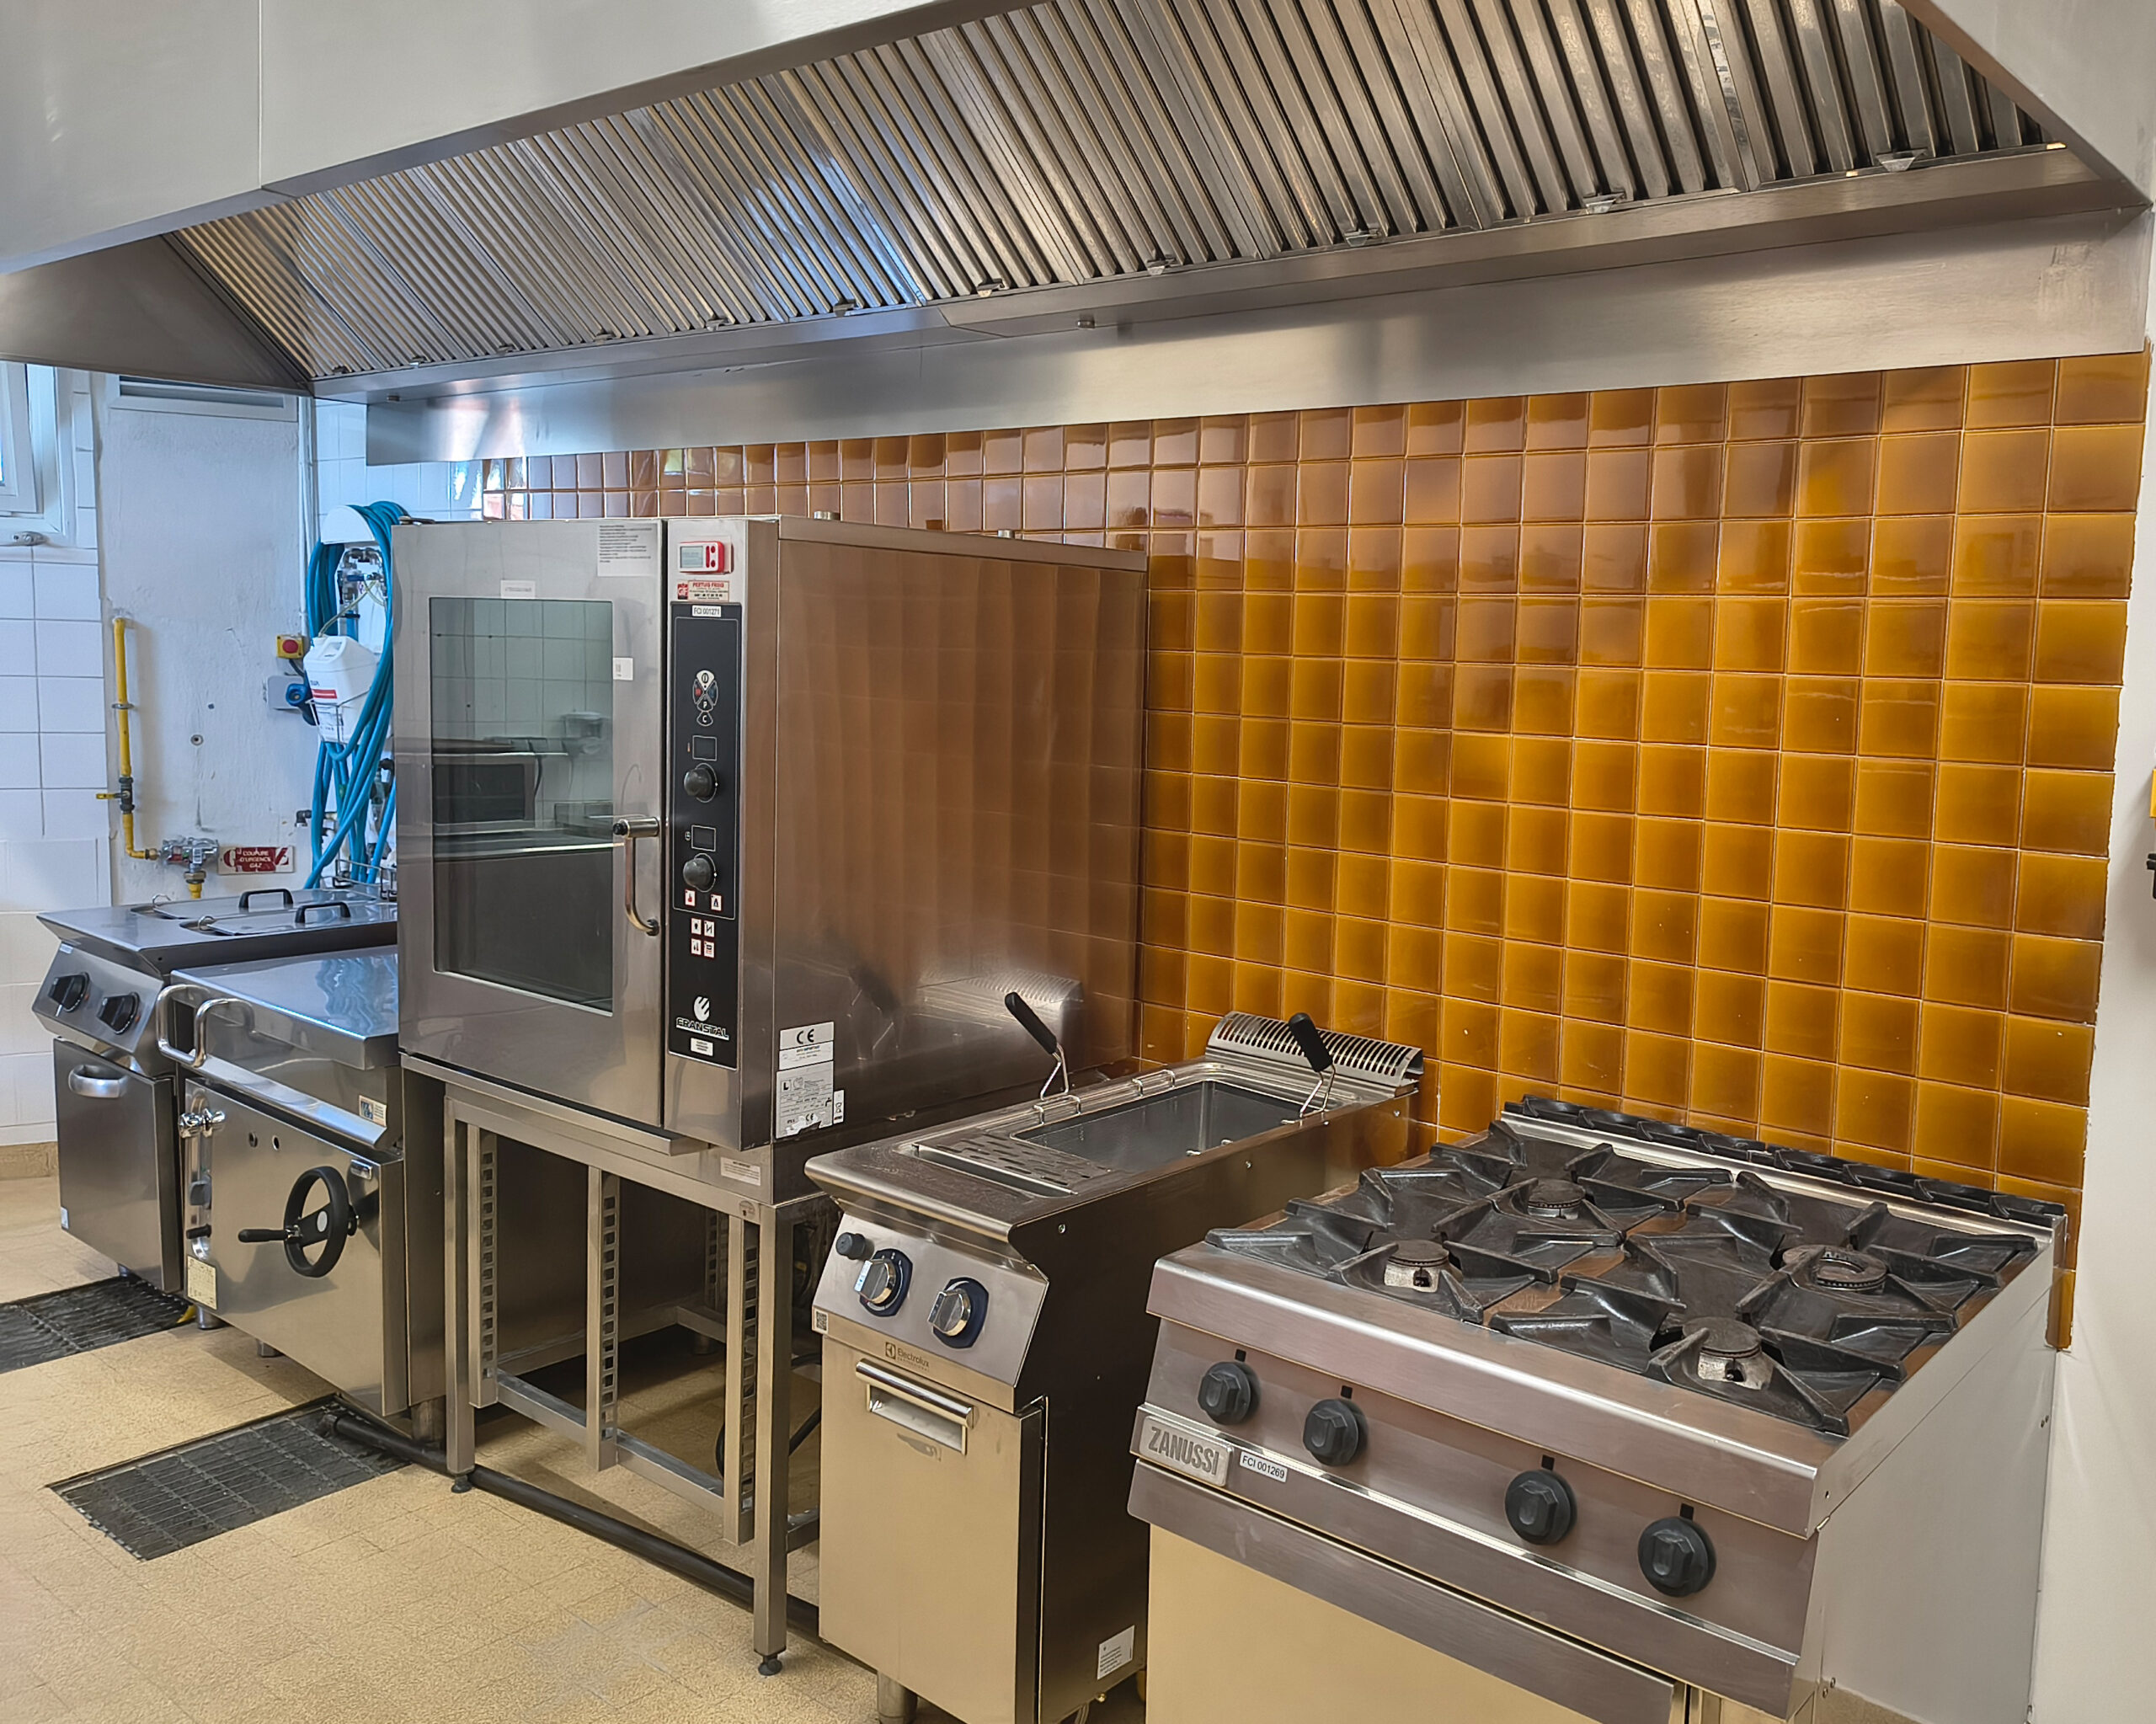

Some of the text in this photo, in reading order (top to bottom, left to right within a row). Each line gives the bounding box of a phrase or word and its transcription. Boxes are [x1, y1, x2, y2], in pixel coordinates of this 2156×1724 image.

[796, 1028, 814, 1044] CE
[897, 1348, 930, 1367] Electrolux
[1148, 1426, 1220, 1476] ZANUSSI
[1241, 1454, 1285, 1479] FCI 001269
